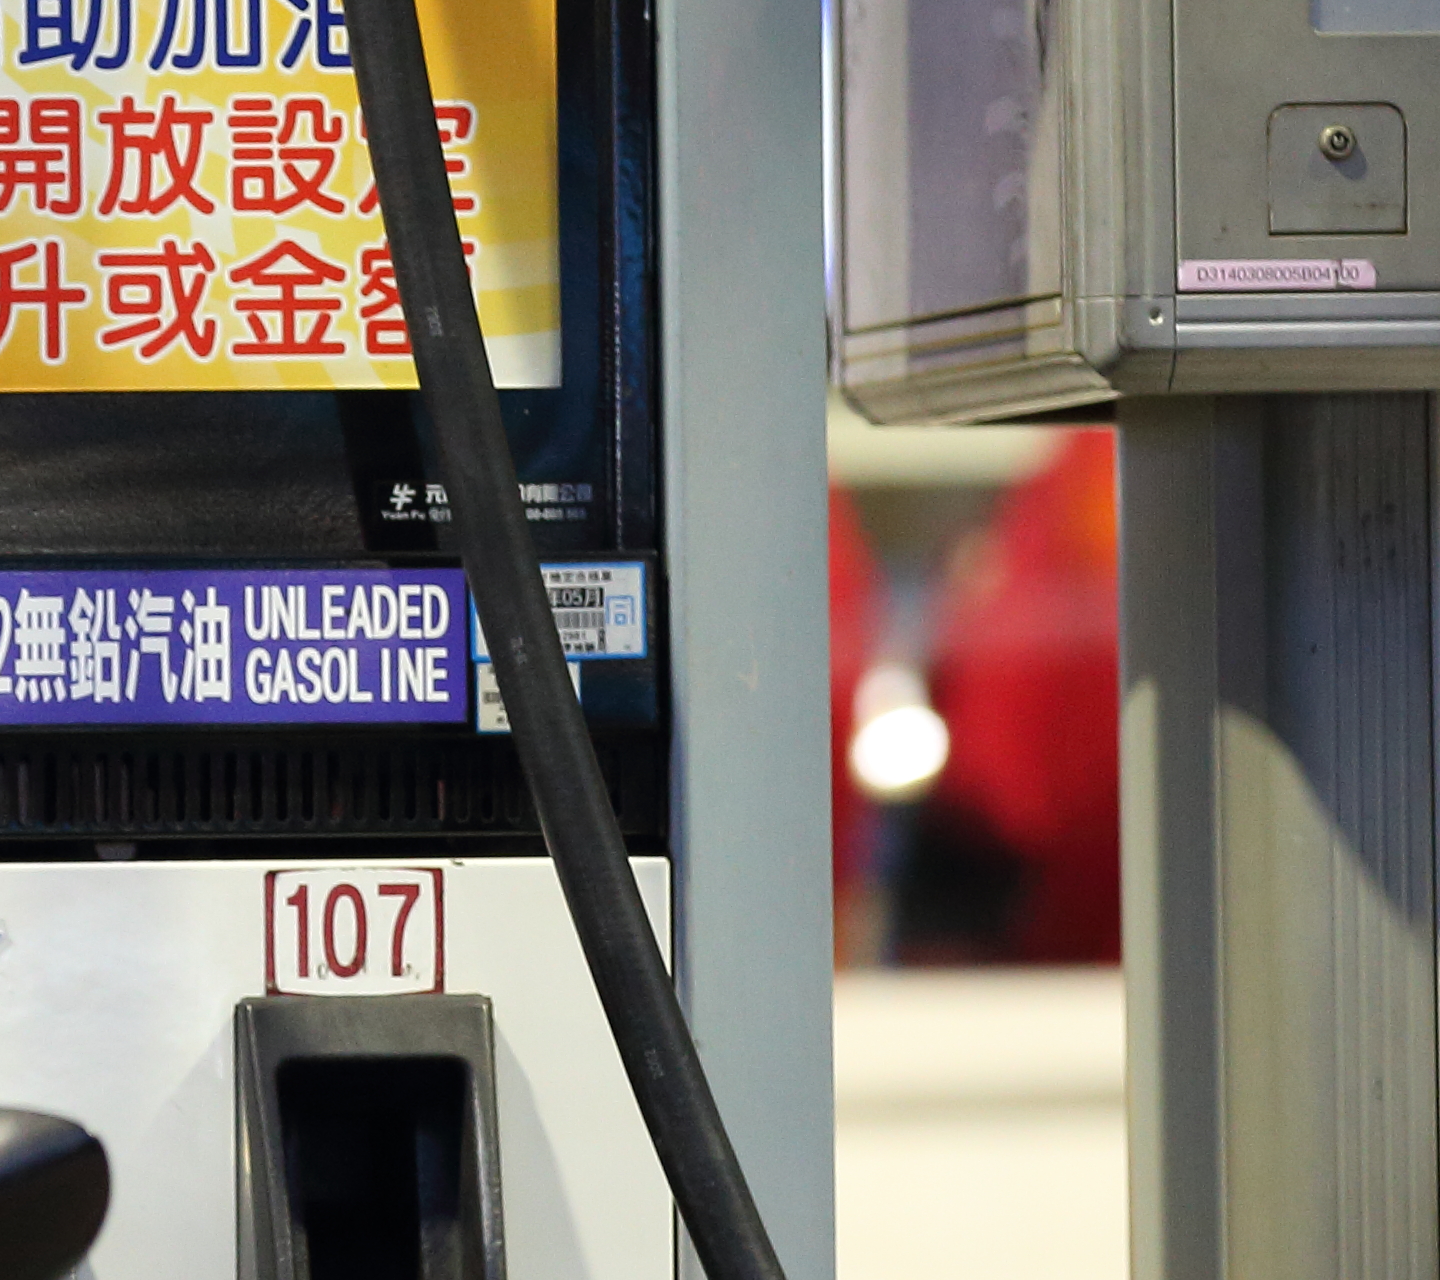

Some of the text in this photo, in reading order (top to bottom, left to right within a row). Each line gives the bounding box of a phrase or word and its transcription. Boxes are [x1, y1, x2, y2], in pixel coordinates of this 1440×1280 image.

[245, 584, 450, 642] UNLEADED
[550, 587, 603, 608] 年05月
[245, 646, 450, 704] GASOLINE
[286, 882, 420, 979] 107
